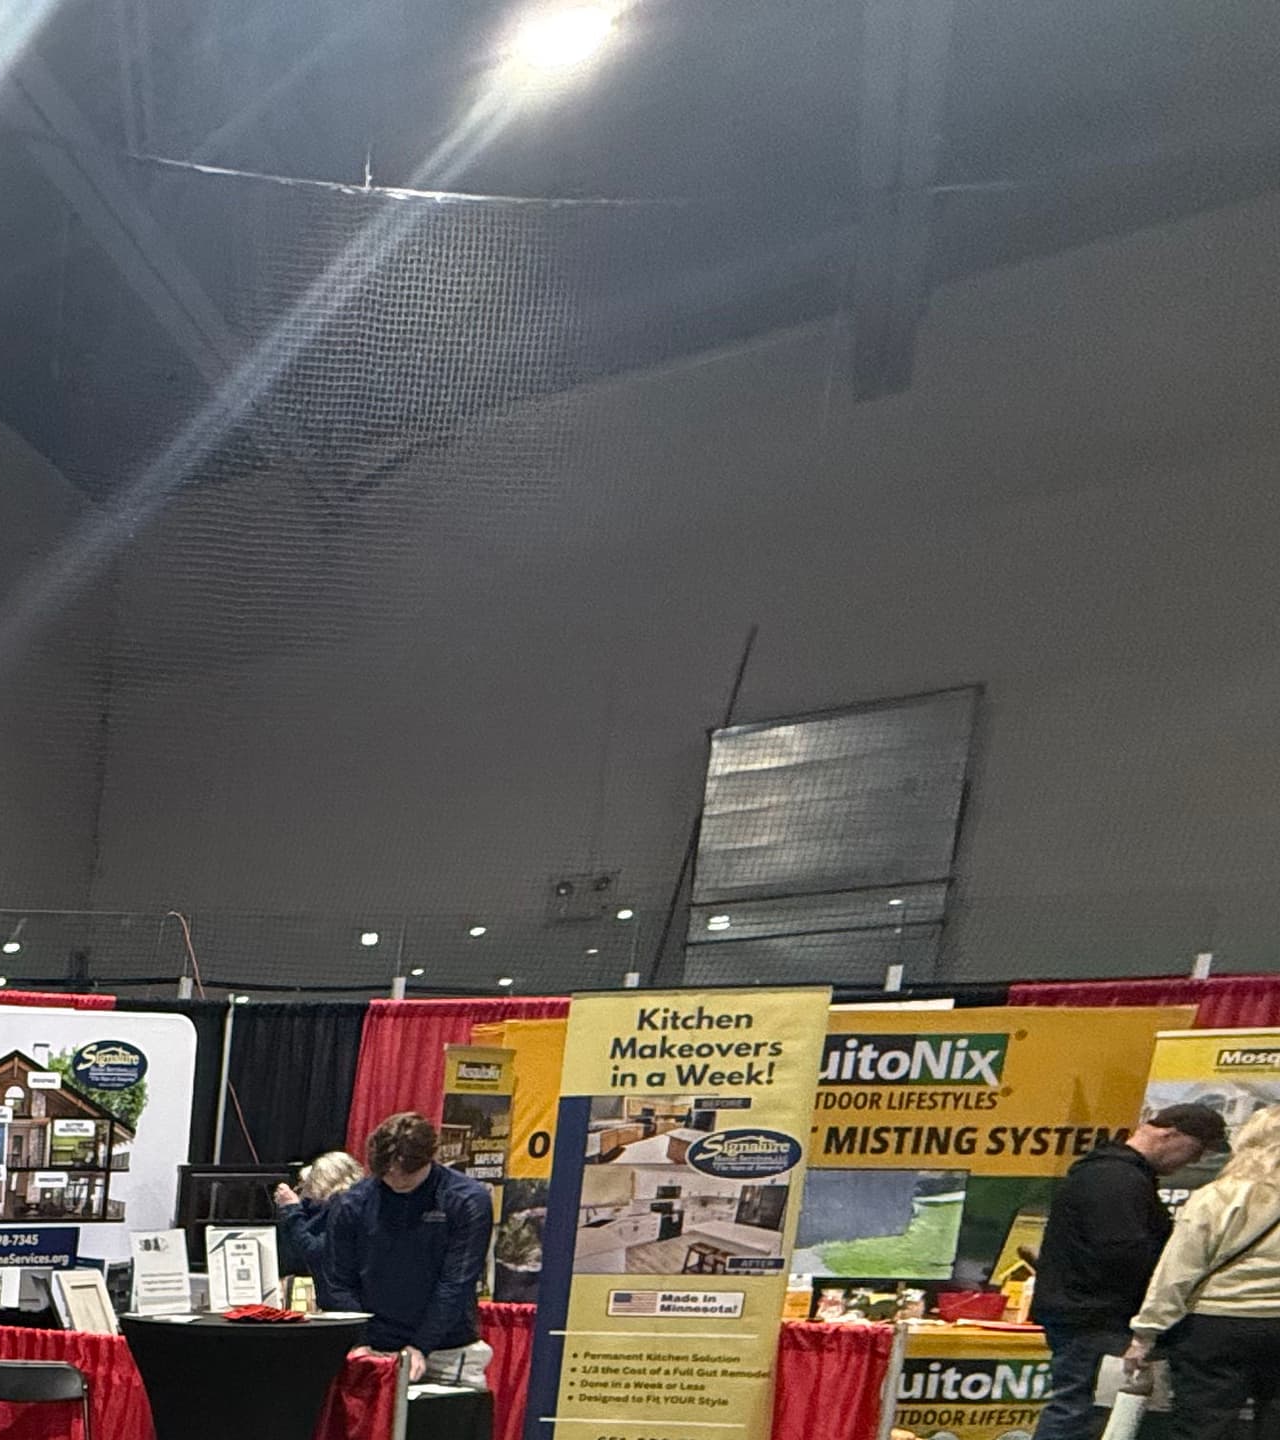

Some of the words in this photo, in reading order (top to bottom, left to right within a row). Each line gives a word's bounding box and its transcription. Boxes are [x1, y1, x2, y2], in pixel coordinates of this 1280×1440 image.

[636, 1006, 753, 1031] Kitchen
[609, 1036, 783, 1060] Makeovers
[819, 1038, 1001, 1088] uitoNix
[610, 1065, 638, 1088] in
[645, 1070, 666, 1088] a
[675, 1062, 776, 1087] Week!
[814, 1091, 882, 1110] TDOOR
[886, 1091, 999, 1111] LIFESTYLES
[694, 1134, 790, 1161] Signature
[823, 1126, 978, 1156] MISTING
[659, 1303, 738, 1314] Minnesota!
[660, 1294, 699, 1304] Made
[582, 1351, 644, 1362] Permanent
[646, 1352, 689, 1363] Kitchen
[691, 1353, 741, 1364] Solution
[580, 1365, 599, 1375] 1/3
[601, 1366, 620, 1375] the
[622, 1366, 648, 1376] Cost
[649, 1366, 663, 1376] of
[673, 1367, 694, 1378] Full
[696, 1368, 718, 1378] Gut
[898, 1362, 1053, 1400] uitoNi
[579, 1379, 609, 1389] Done
[611, 1379, 622, 1389] in
[633, 1380, 663, 1390] Week
[680, 1382, 706, 1391] Less
[578, 1392, 629, 1404] Designed
[631, 1395, 644, 1404] to
[646, 1394, 661, 1404] Fit
[663, 1396, 696, 1405] YOUR
[698, 1396, 729, 1407] Style
[894, 1409, 963, 1425] TDOOR
[969, 1409, 1040, 1425] LIFESTY
